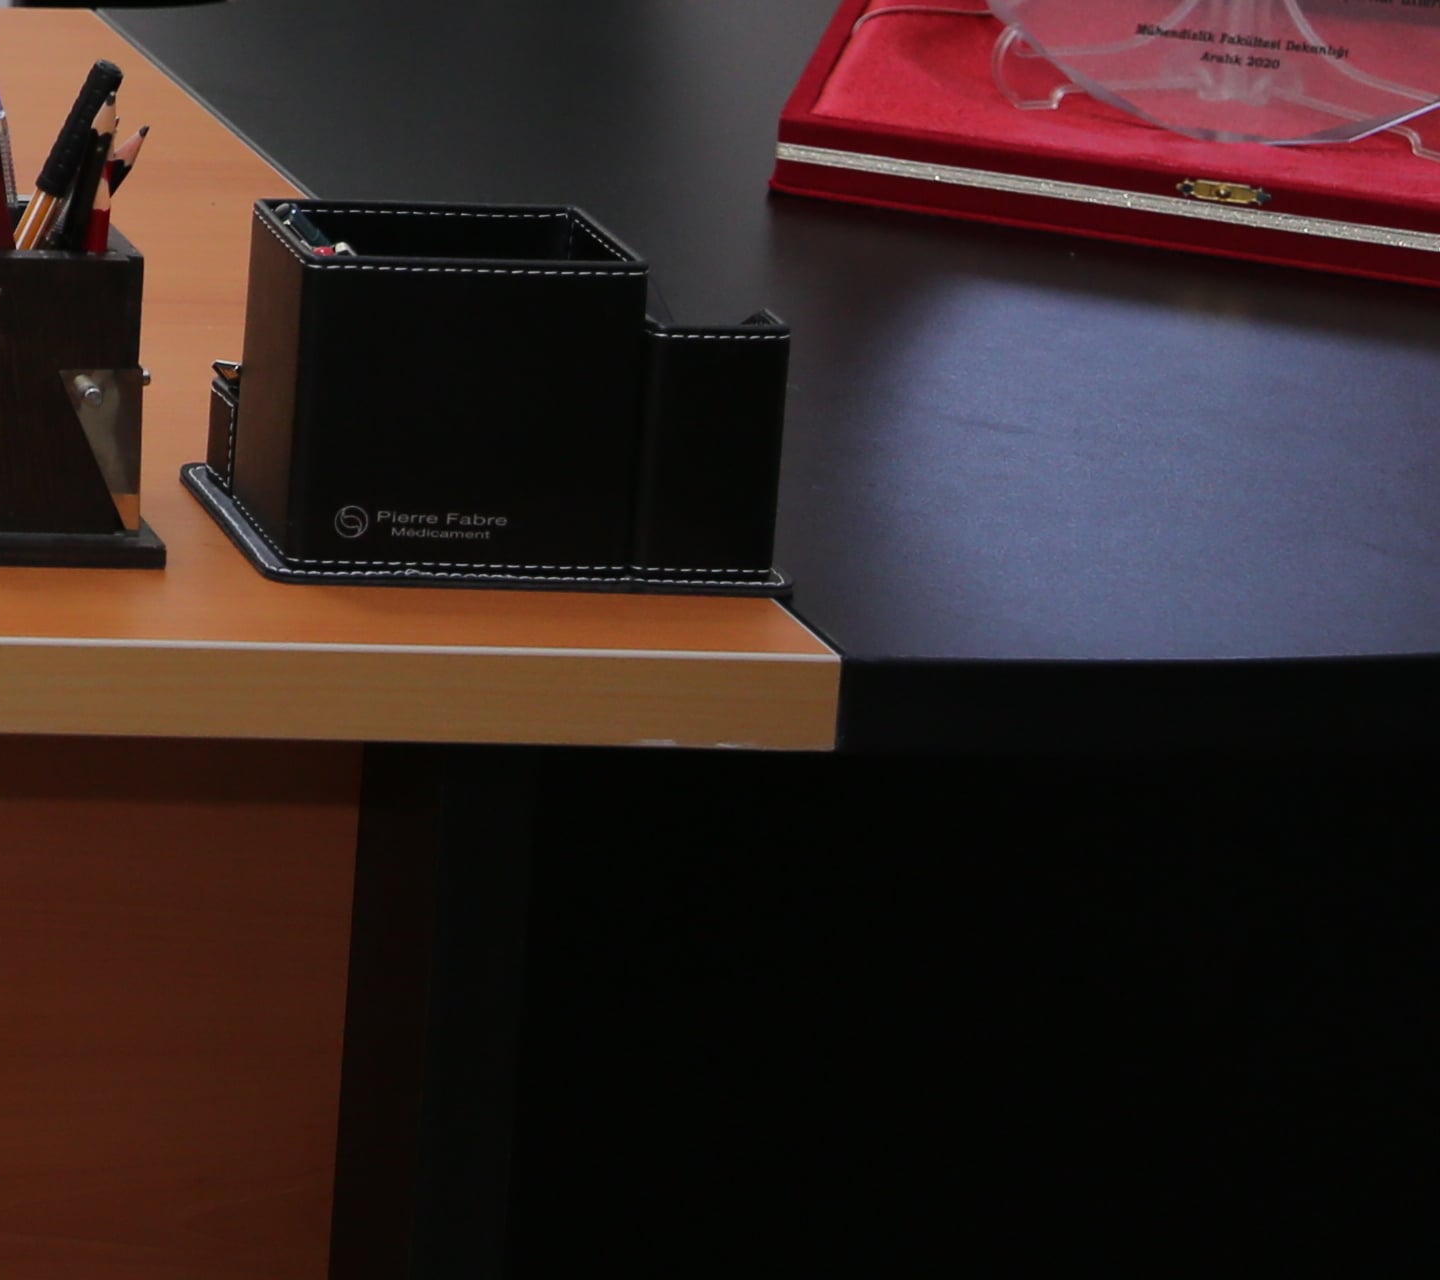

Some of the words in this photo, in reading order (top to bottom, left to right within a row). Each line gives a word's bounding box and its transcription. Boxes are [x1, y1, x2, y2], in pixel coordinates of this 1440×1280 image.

[1136, 23, 1216, 44] Mühendislik
[1219, 31, 1281, 51] Fakültesi
[1285, 40, 1349, 60] Dekanlığı
[1200, 52, 1241, 66] Aralık
[1247, 56, 1280, 70] 2020
[376, 510, 439, 525] Pierre
[446, 512, 508, 527] Fabre
[390, 526, 491, 540] Médicament
